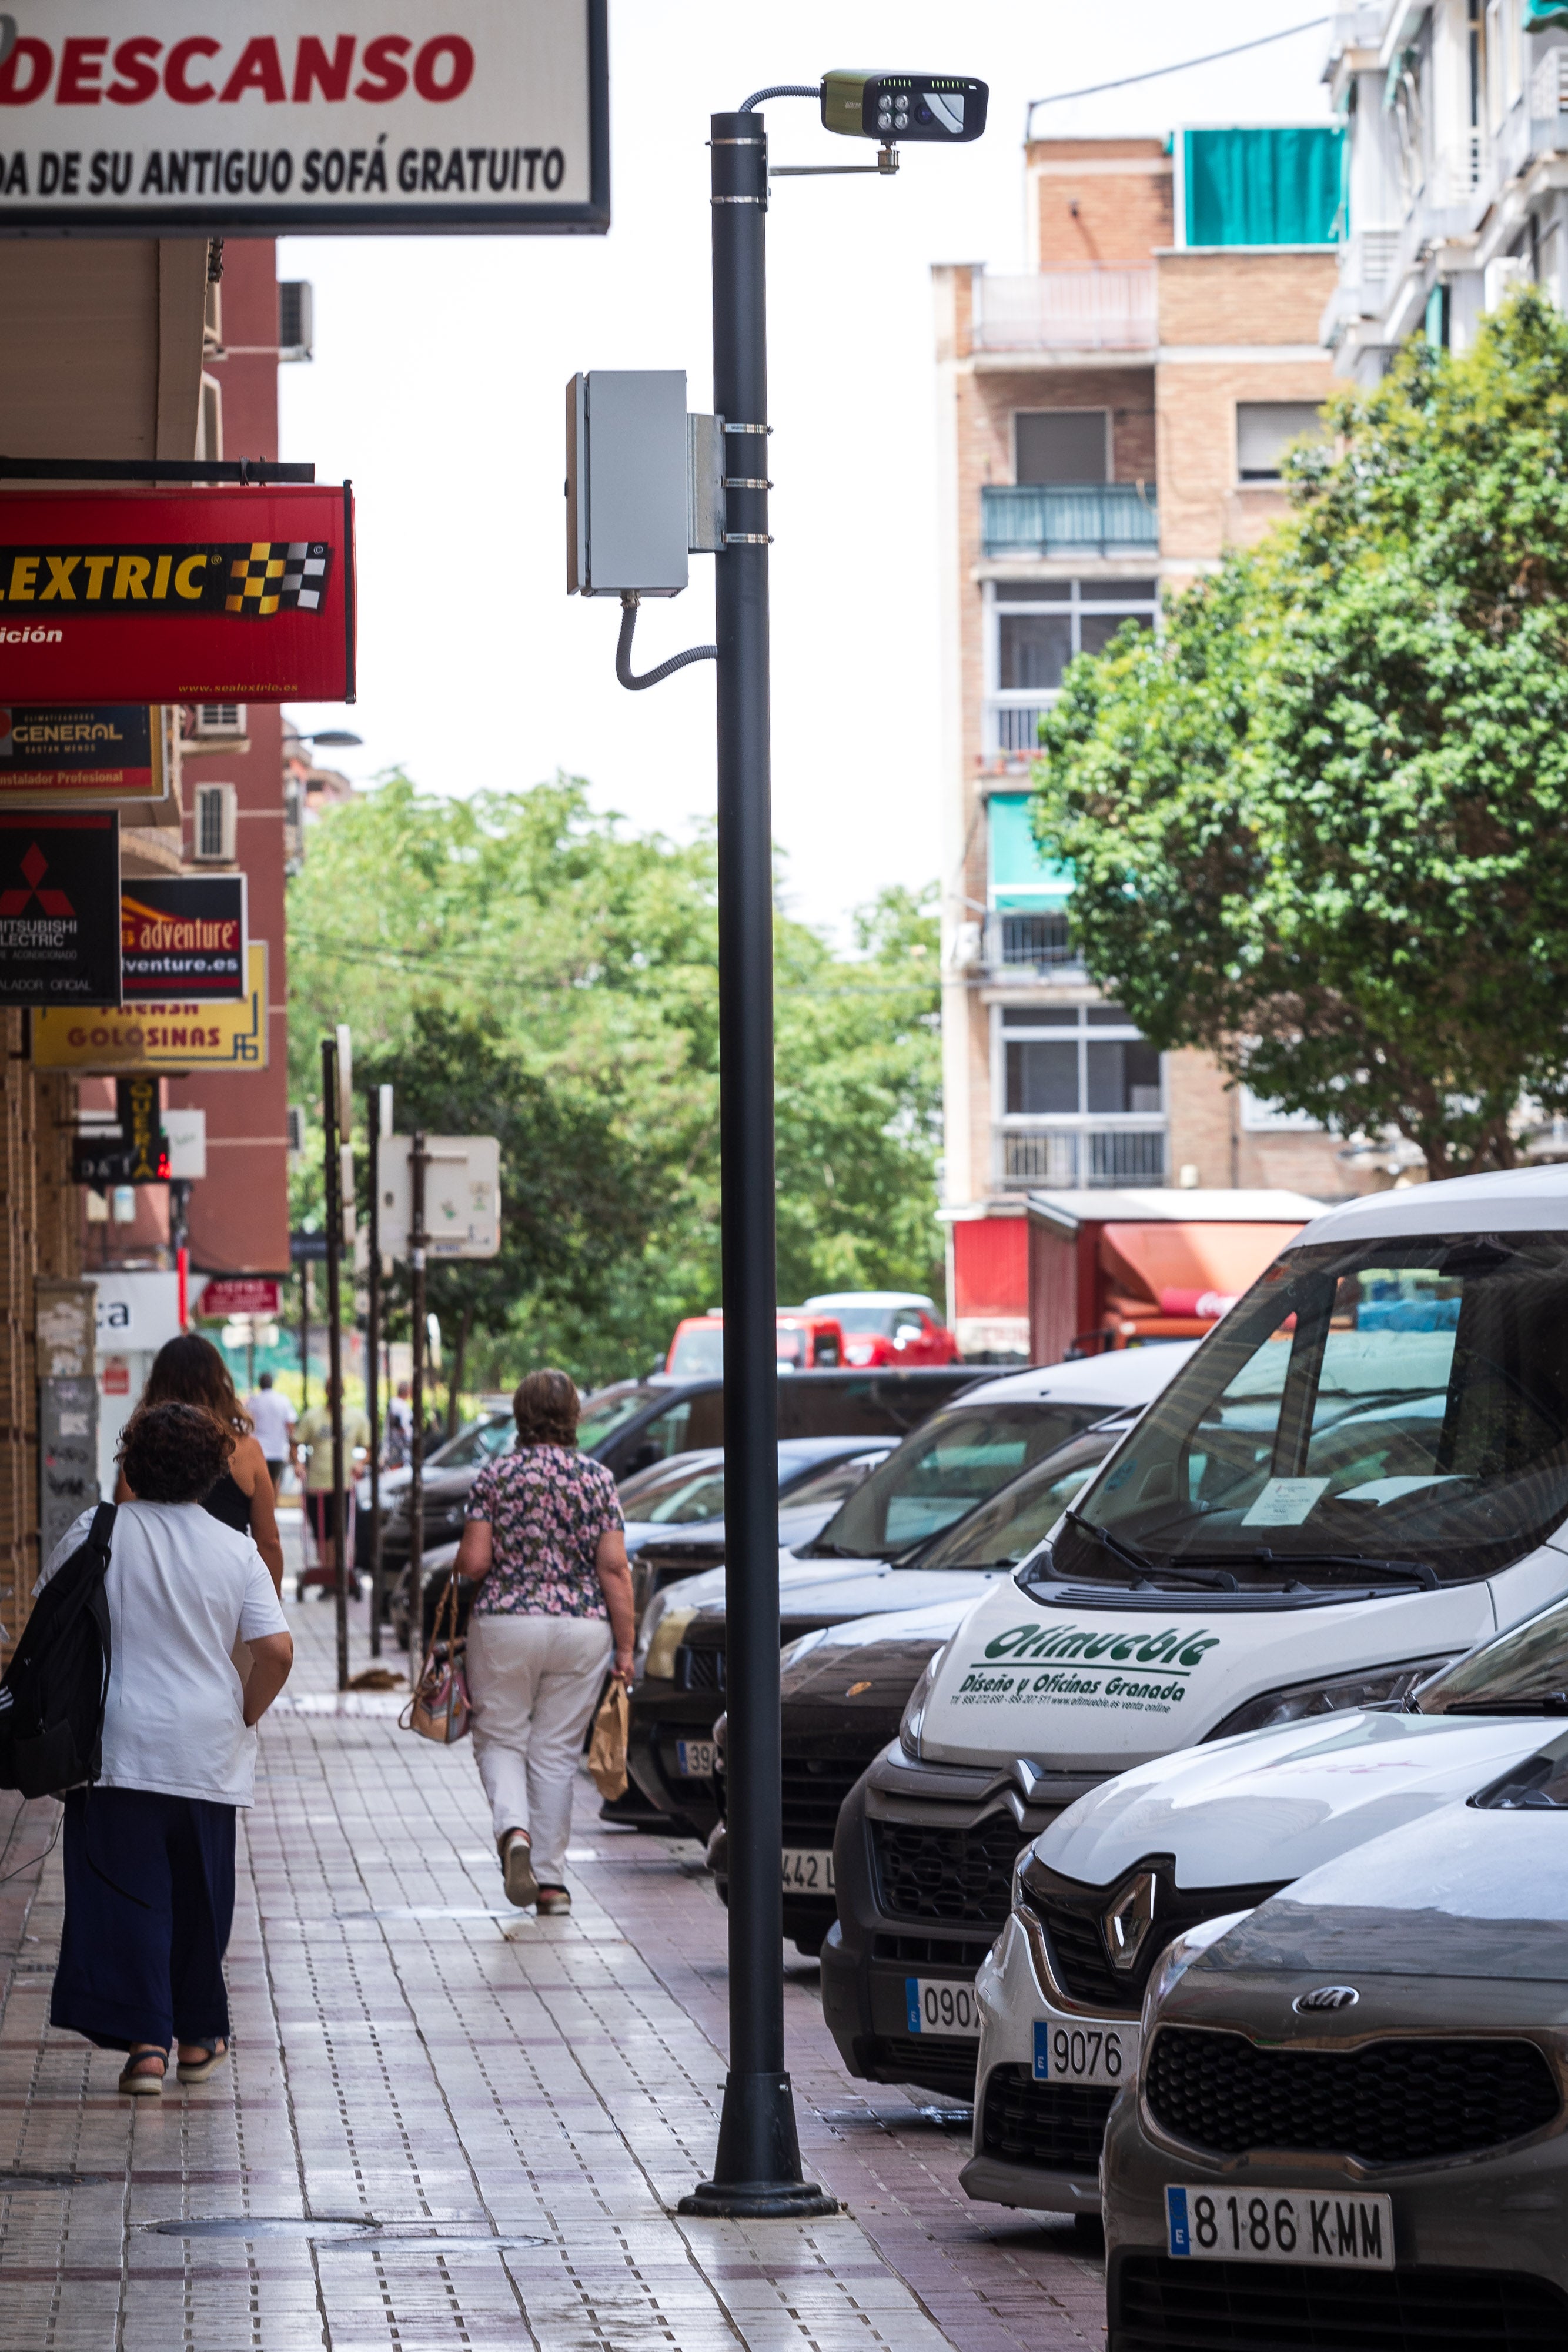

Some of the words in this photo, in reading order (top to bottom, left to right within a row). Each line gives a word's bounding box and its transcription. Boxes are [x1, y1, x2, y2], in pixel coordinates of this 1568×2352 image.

[0, 34, 474, 106] DESCANSO
[38, 151, 81, 196] DE
[88, 149, 132, 195] SU
[140, 149, 293, 195] ANTIGUO
[300, 132, 388, 193] SOFÁ
[398, 147, 566, 192] GRATUITO
[0, 554, 207, 601] EXTRIC
[12, 723, 123, 742] GENERAL
[58, 770, 123, 784] Profesional
[140, 916, 233, 951] adventure
[67, 1026, 220, 1048] GOLOSINAS
[984, 1623, 1221, 1666] Ofimueble
[959, 1672, 1014, 1692] Diseño
[1017, 1678, 1031, 1696] y
[1033, 1672, 1102, 1694] Oficinas
[1105, 1676, 1186, 1702] Granada
[1054, 2028, 1122, 2077] 9076
[1195, 2194, 1297, 2252] 8186
[1310, 2199, 1383, 2260] KMM
